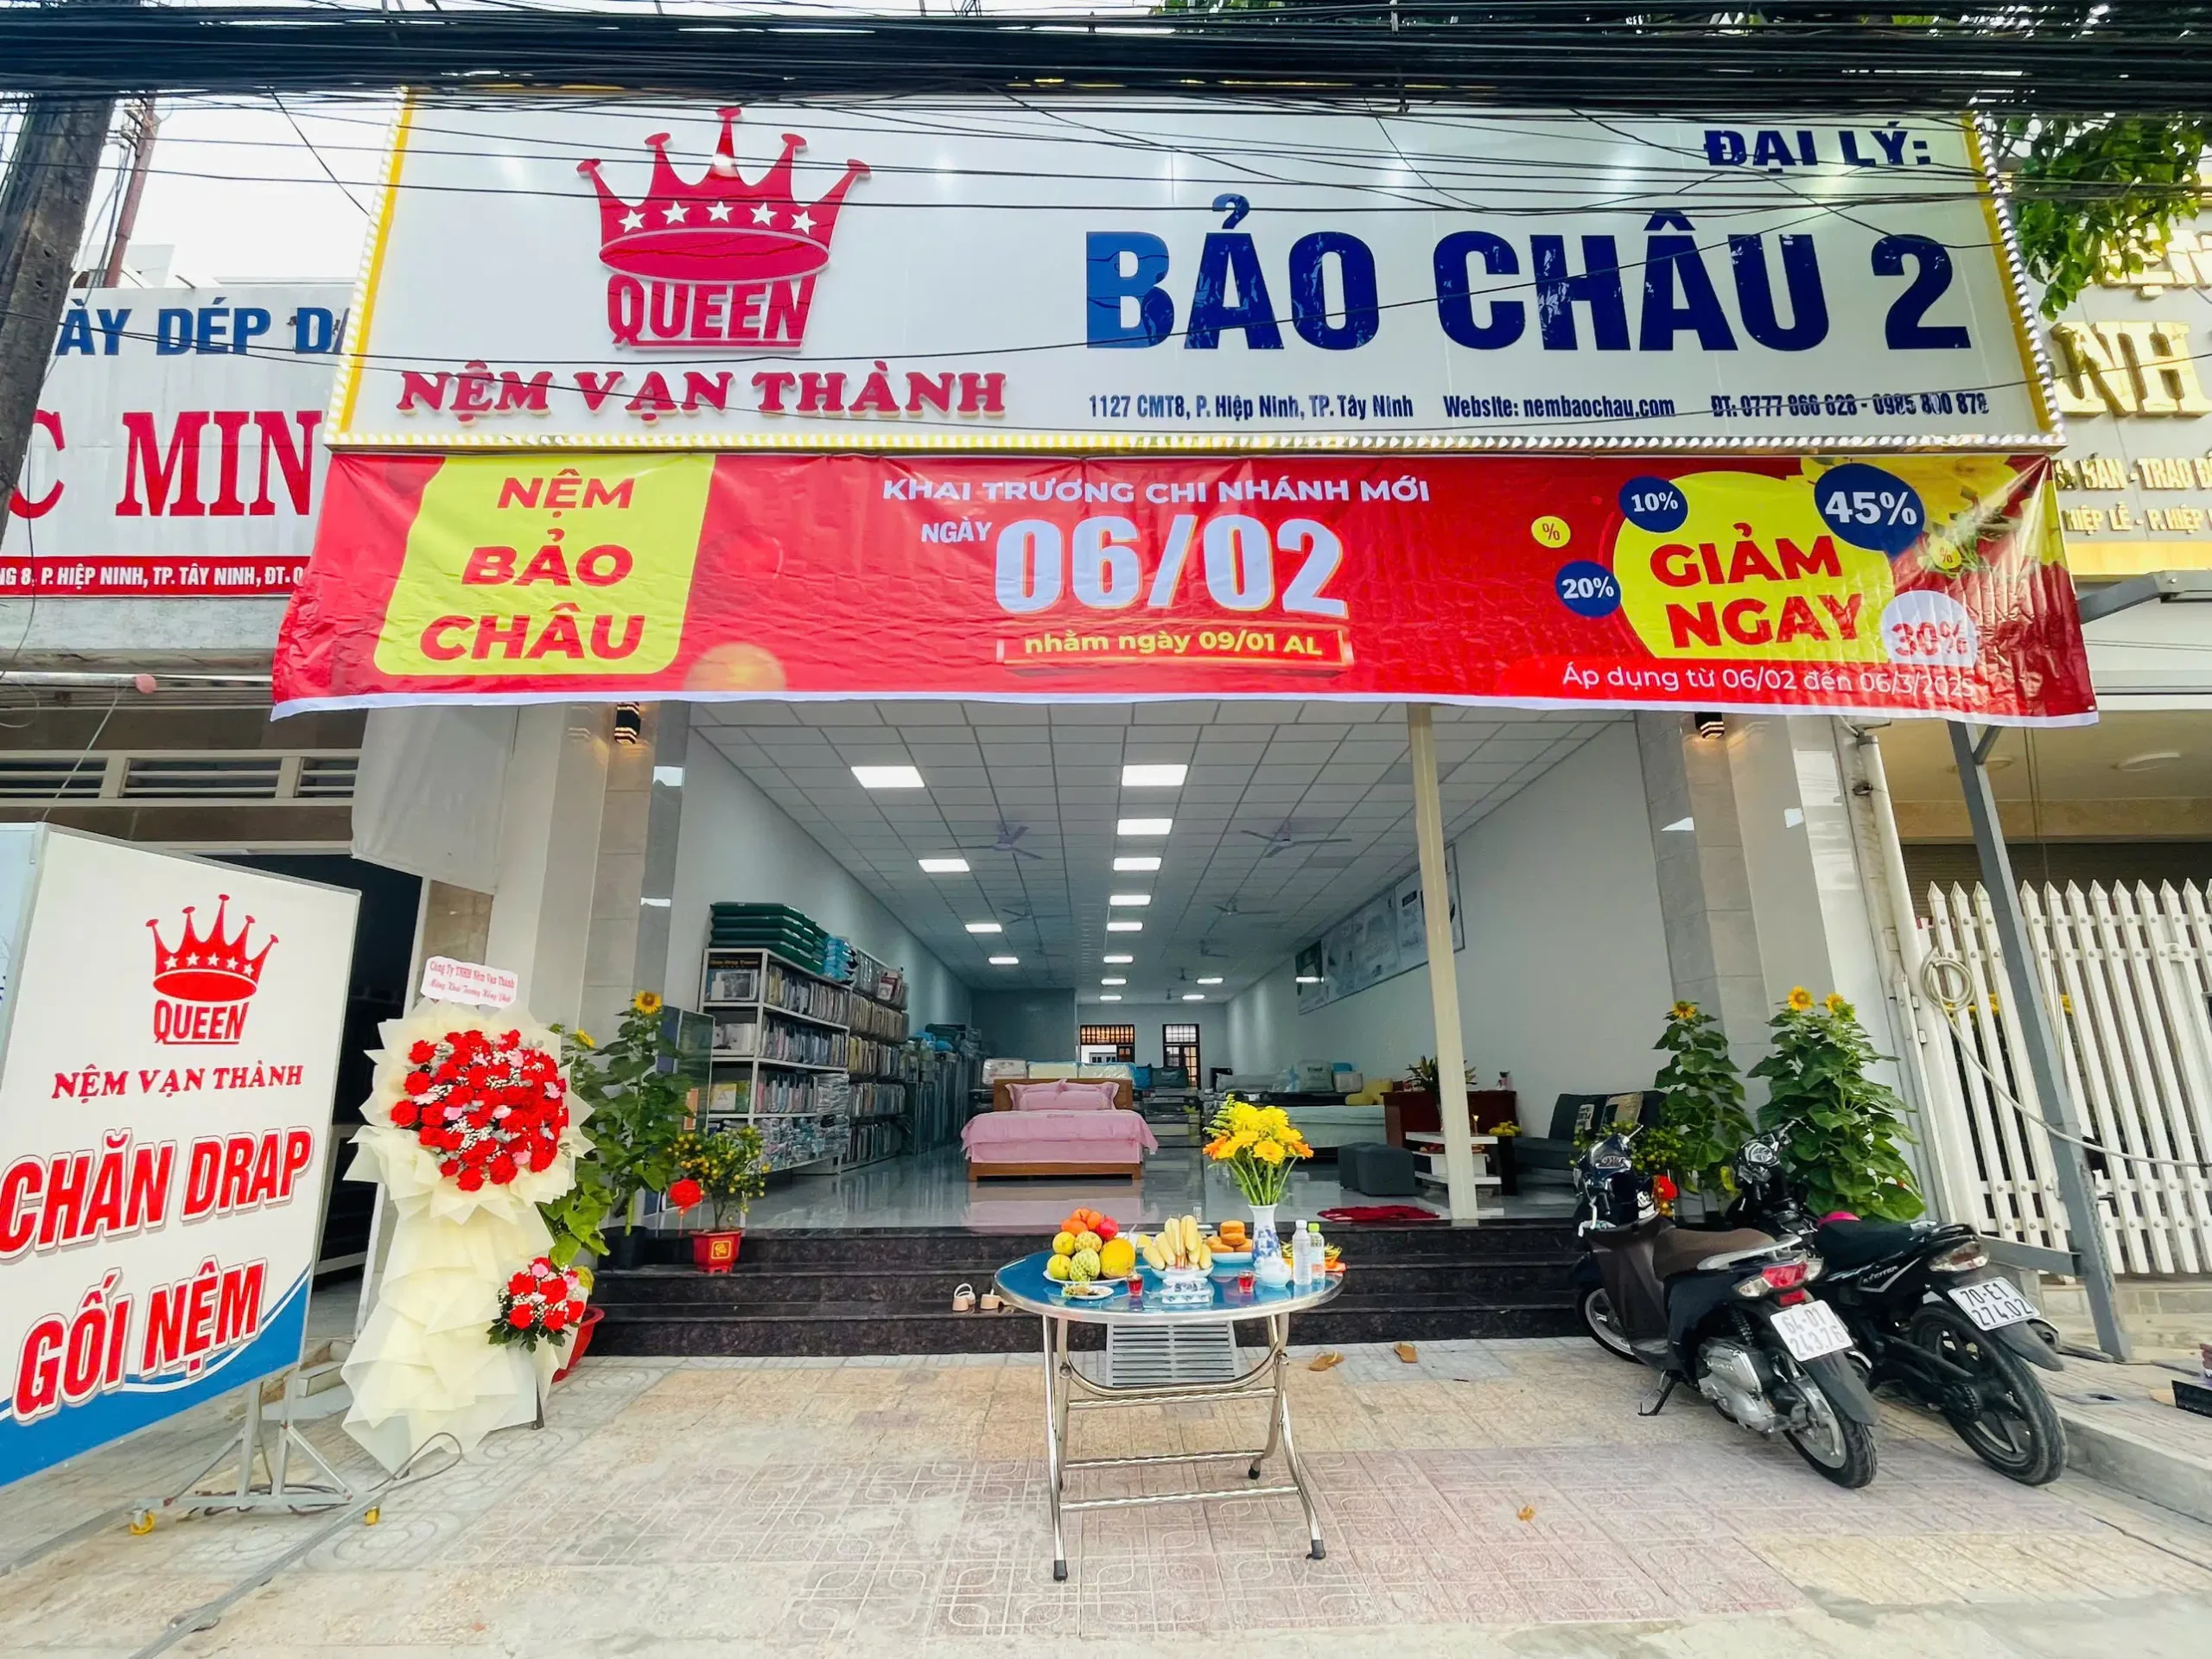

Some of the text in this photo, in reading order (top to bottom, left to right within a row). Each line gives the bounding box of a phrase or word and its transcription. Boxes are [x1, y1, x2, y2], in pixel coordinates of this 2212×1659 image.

[1704, 120, 1931, 174] ĐẠI LÝ:
[1086, 193, 1379, 350] BẢO
[1433, 210, 1830, 351] CHÂU
[1871, 233, 1972, 350] 2
[156, 296, 271, 356] DÉP
[295, 307, 351, 355] D
[607, 273, 818, 346] QUEEN
[396, 359, 1008, 427] NỆM VẠN THÀNH
[1089, 394, 1414, 422] 1127 CMT8, P. Hiệp Ninh, TP. Tây Ninh
[1442, 395, 1675, 417] Website: nembaochau.com
[1710, 395, 1738, 416] ĐT:
[1740, 395, 1783, 416] 0777
[1824, 393, 1858, 416] 628
[1872, 393, 1916, 415] 0985
[496, 467, 636, 518] NỆM
[882, 474, 1431, 505] KHAI TRƯƠNG CHI NHÁNH MỚI
[2137, 456, 2196, 490] TRAO
[1630, 491, 1679, 513] 10%
[1824, 491, 1917, 526] 45%
[41, 567, 54, 586] P.
[56, 563, 96, 590] HIỆP
[99, 567, 149, 588] NINH,
[152, 566, 175, 586] TP.
[178, 563, 210, 586] TÂY
[213, 566, 261, 588] NINH,
[461, 527, 634, 588] BẢO
[921, 513, 1349, 620] NGÀY 06/02
[1649, 521, 1843, 588] GIẢM
[1560, 575, 1615, 600] 20%
[419, 601, 645, 663] CHÂU
[1665, 592, 1863, 648] NGAY
[1891, 620, 1969, 657] 30%
[1025, 629, 1323, 656] nhằm ngày 09/01 AL
[1562, 660, 1974, 698] Áp dụng từ 06/02 đến 06/3/2025
[153, 999, 250, 1044] QUEEN
[51, 1059, 304, 1103] NỆM VẠN THÀNH
[0, 1128, 312, 1257] CHĂN DRAP
[1959, 1282, 2010, 1307] 70-E1
[1971, 1298, 2033, 1326] 274.02
[16, 1260, 266, 1420] GỐI NỆM
